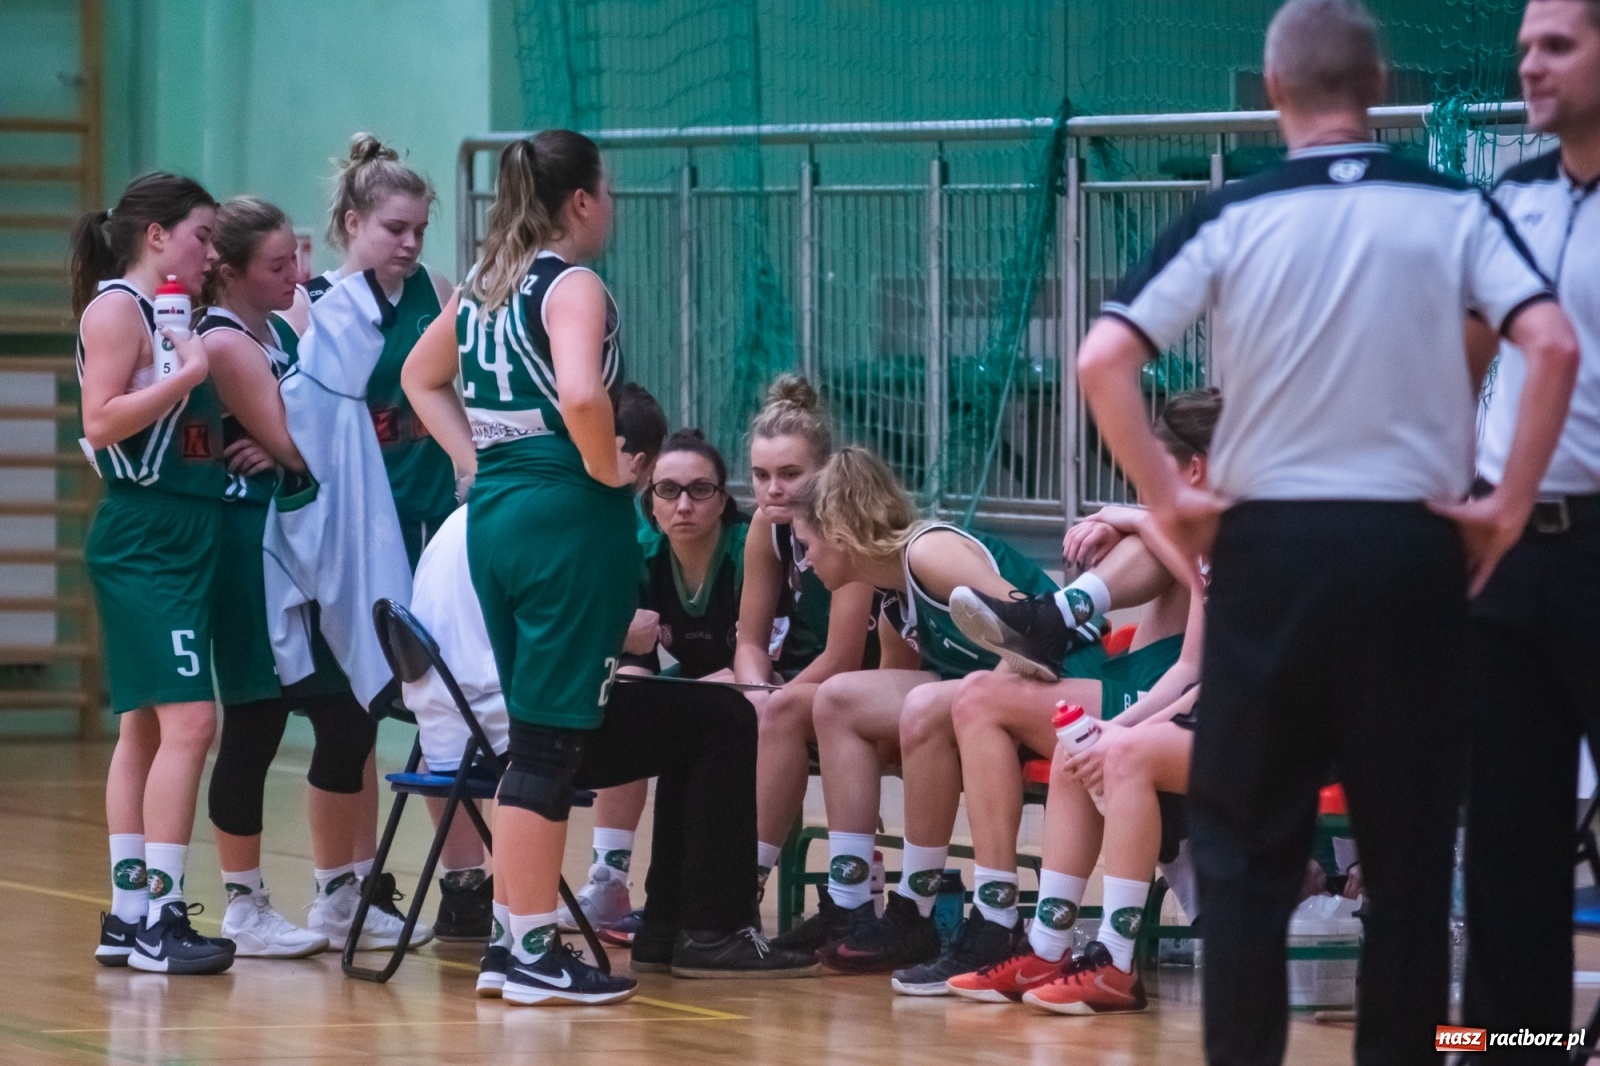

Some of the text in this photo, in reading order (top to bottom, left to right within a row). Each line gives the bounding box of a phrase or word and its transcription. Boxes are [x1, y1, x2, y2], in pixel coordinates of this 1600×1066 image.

[163, 362, 171, 374] 5
[457, 297, 513, 401] 24
[171, 629, 200, 677] 5
[597, 656, 620, 707] 2
